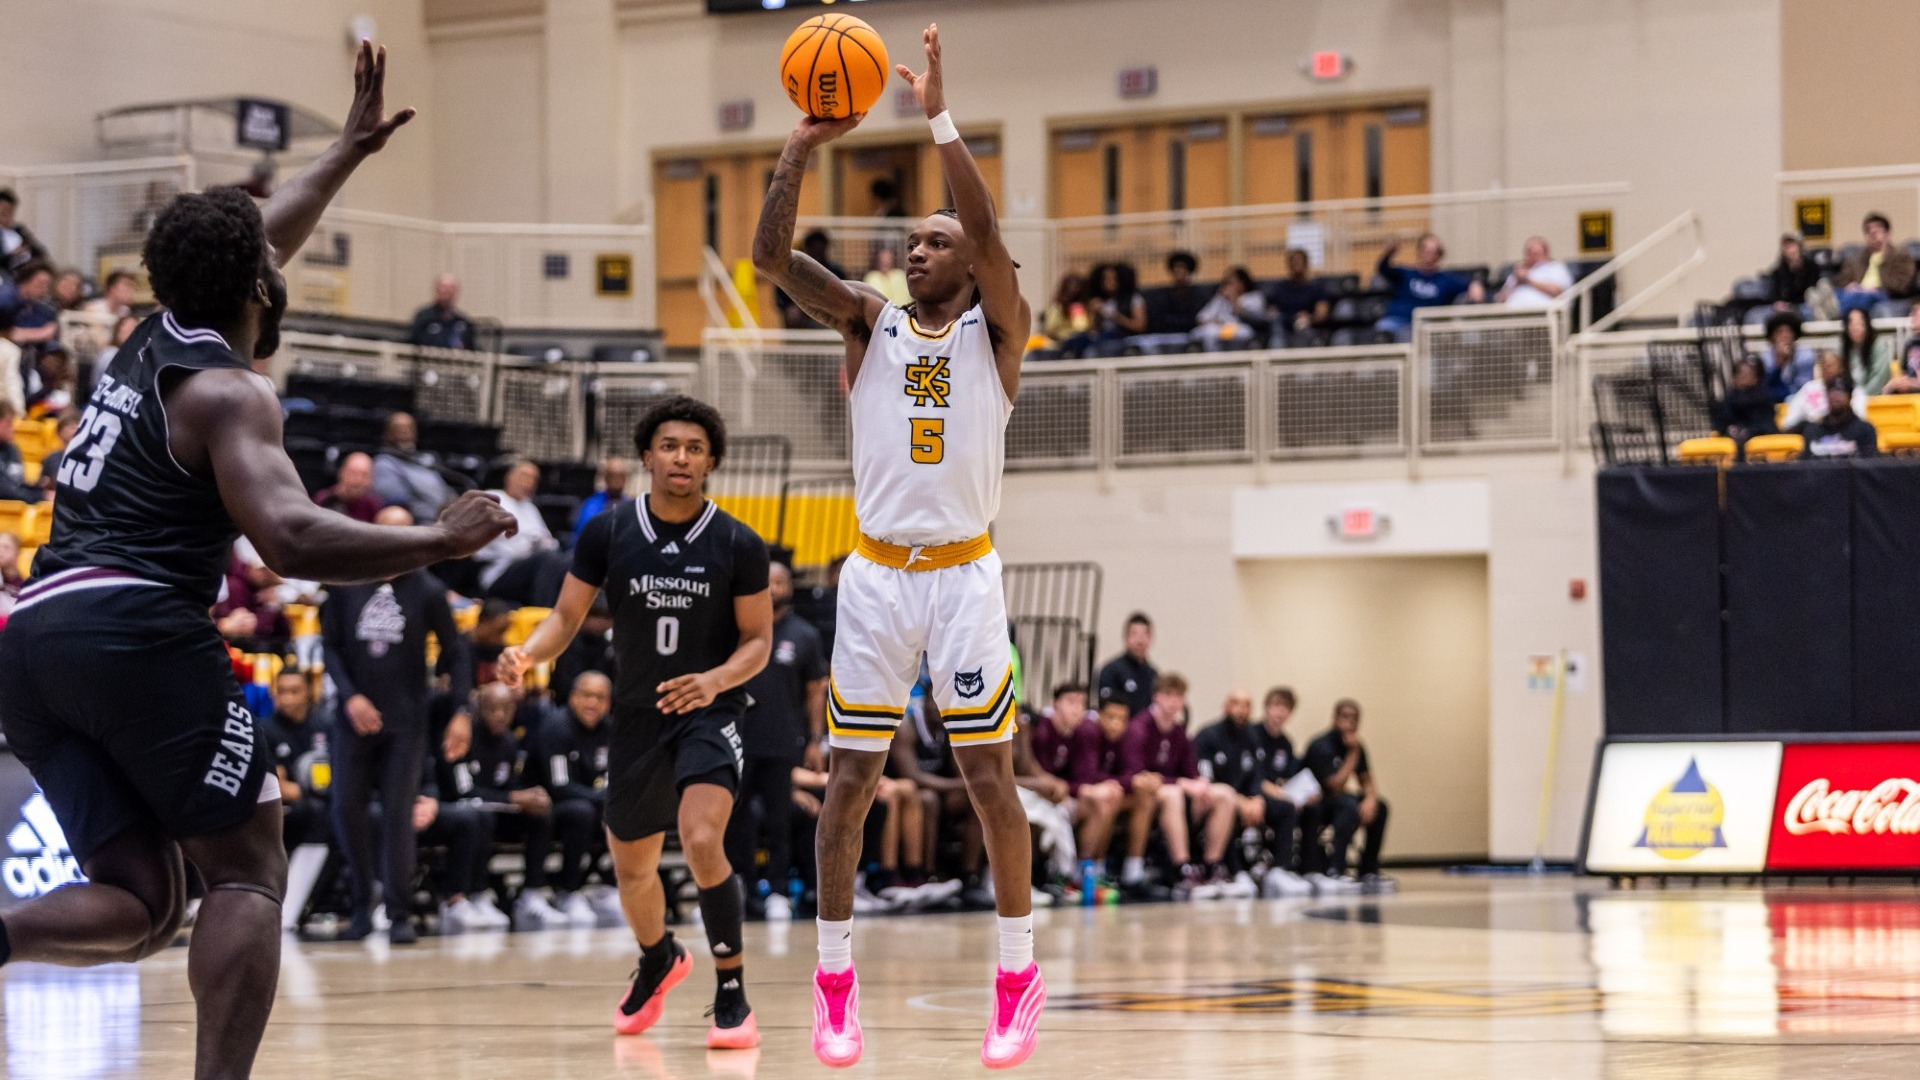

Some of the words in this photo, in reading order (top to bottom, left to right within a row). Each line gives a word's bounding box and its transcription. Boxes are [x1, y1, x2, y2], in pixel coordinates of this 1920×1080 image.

[56, 404, 122, 493] 23
[908, 417, 945, 464] 5
[629, 574, 710, 597] Missouri
[645, 590, 693, 610] State
[656, 615, 680, 656] 0
[203, 701, 254, 797] BEARS
